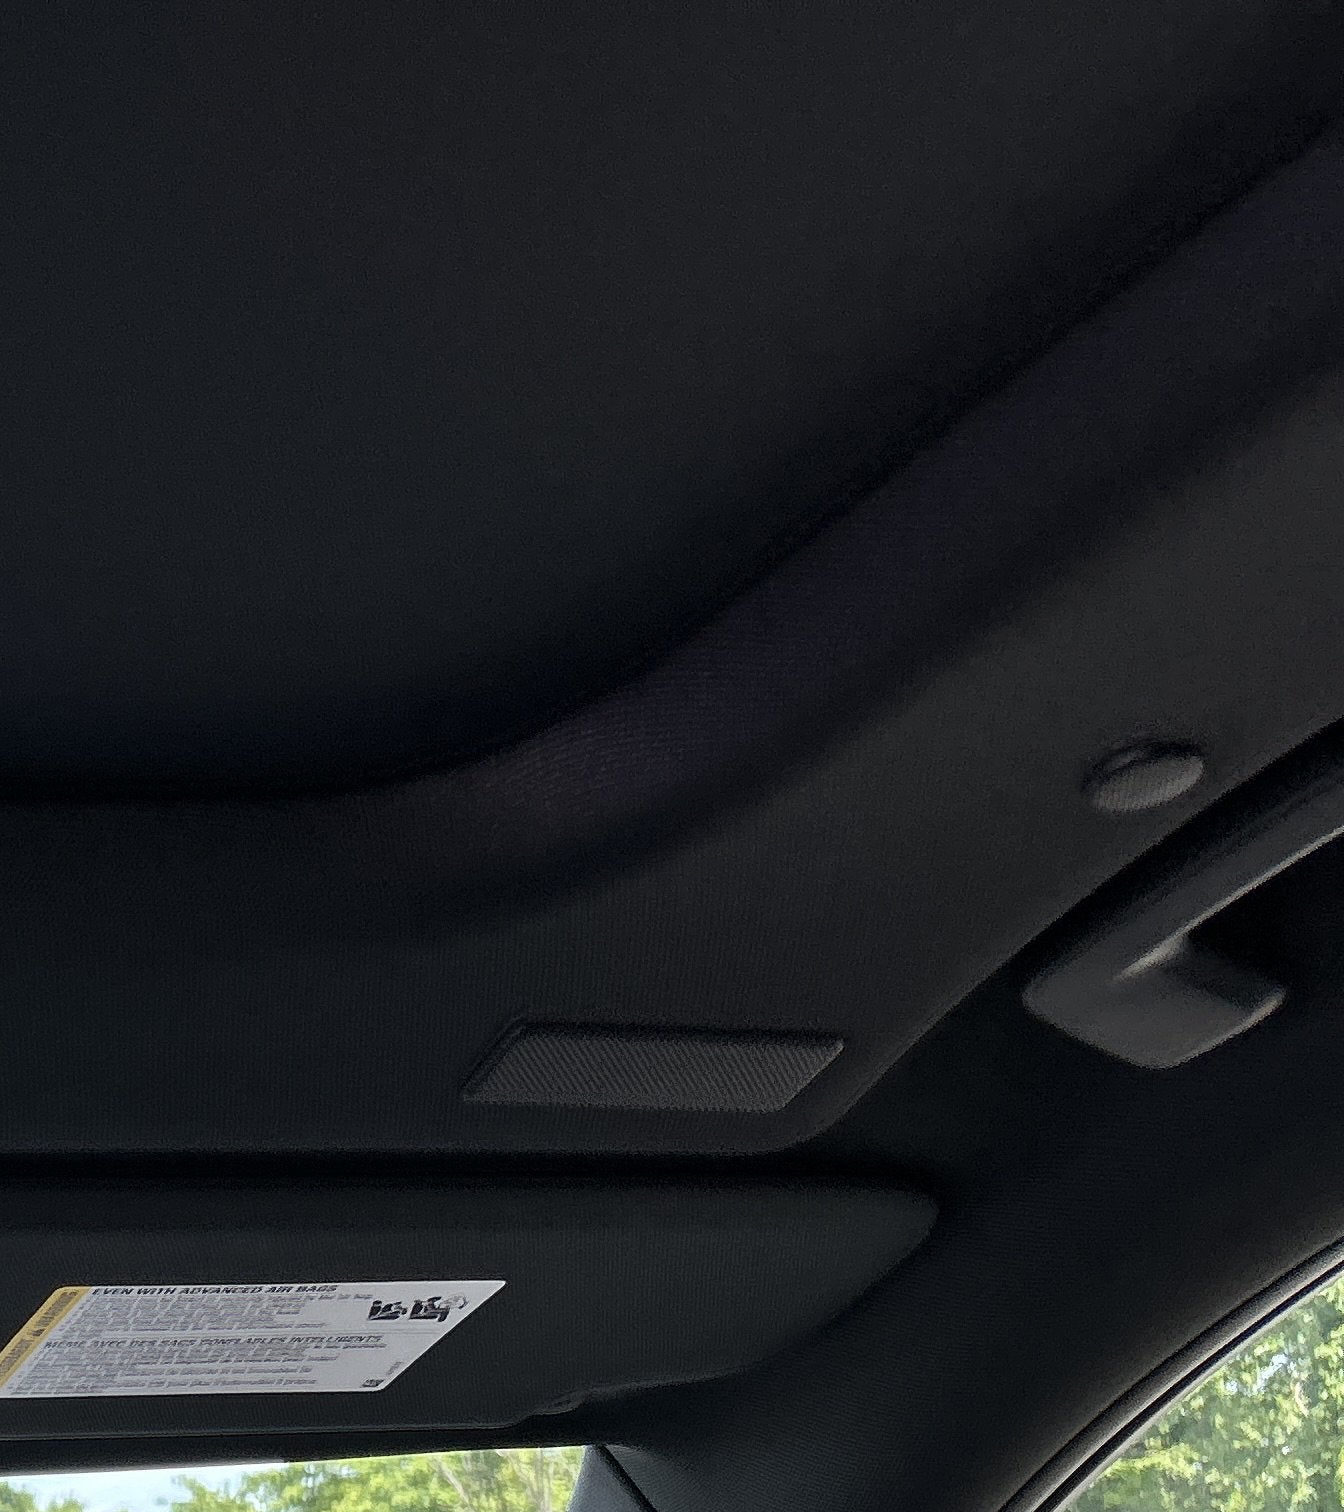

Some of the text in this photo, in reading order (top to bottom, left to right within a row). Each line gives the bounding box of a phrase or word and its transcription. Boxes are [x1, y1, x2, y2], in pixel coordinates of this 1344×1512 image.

[136, 1286, 176, 1295] WITH
[178, 1285, 265, 1295] ADVANCED
[296, 1284, 338, 1293] BAGS
